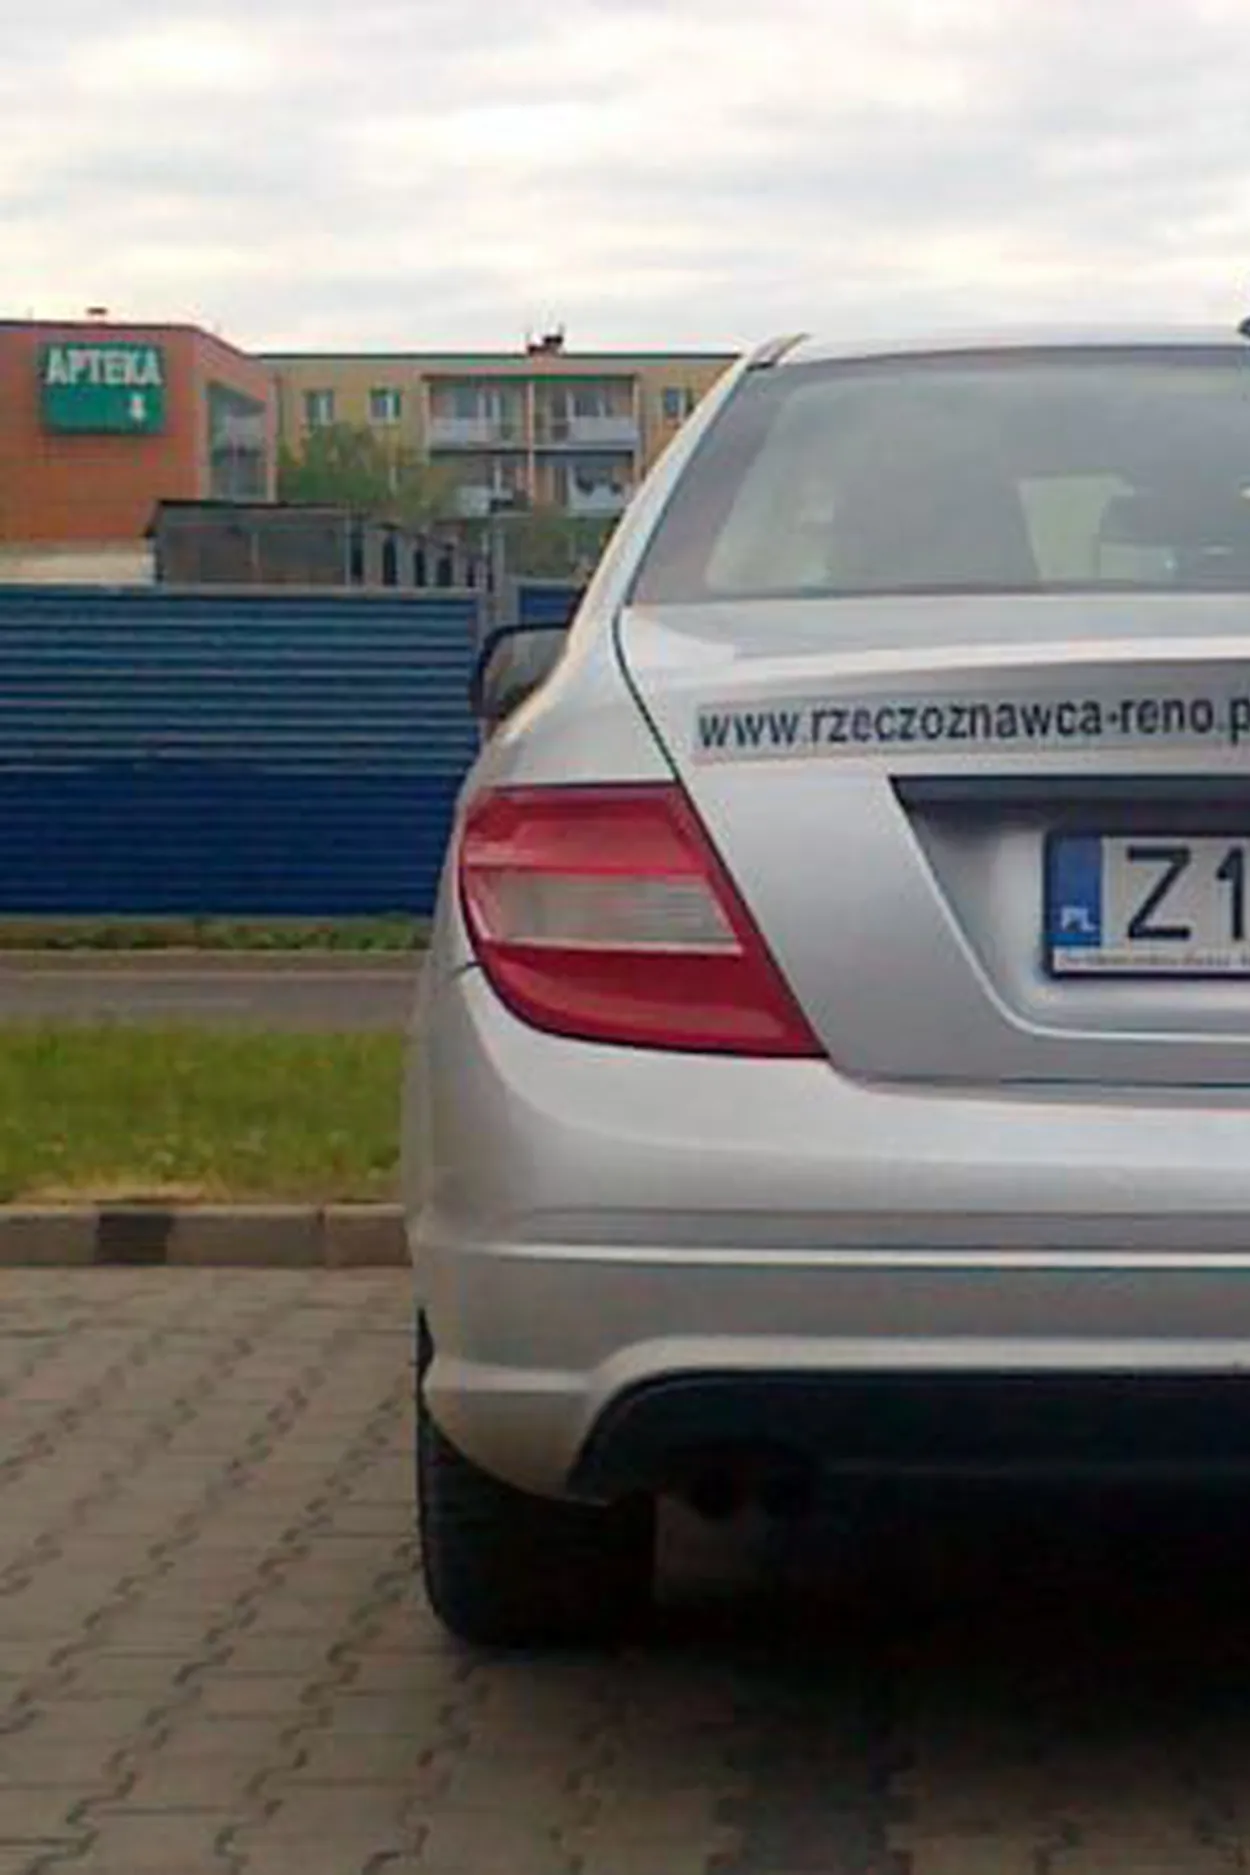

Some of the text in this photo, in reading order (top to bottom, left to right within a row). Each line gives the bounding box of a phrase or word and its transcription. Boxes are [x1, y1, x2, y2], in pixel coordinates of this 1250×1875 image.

[46, 349, 162, 385] APTEKA
[1125, 845, 1246, 941] Z1
[1060, 906, 1097, 931] PL
